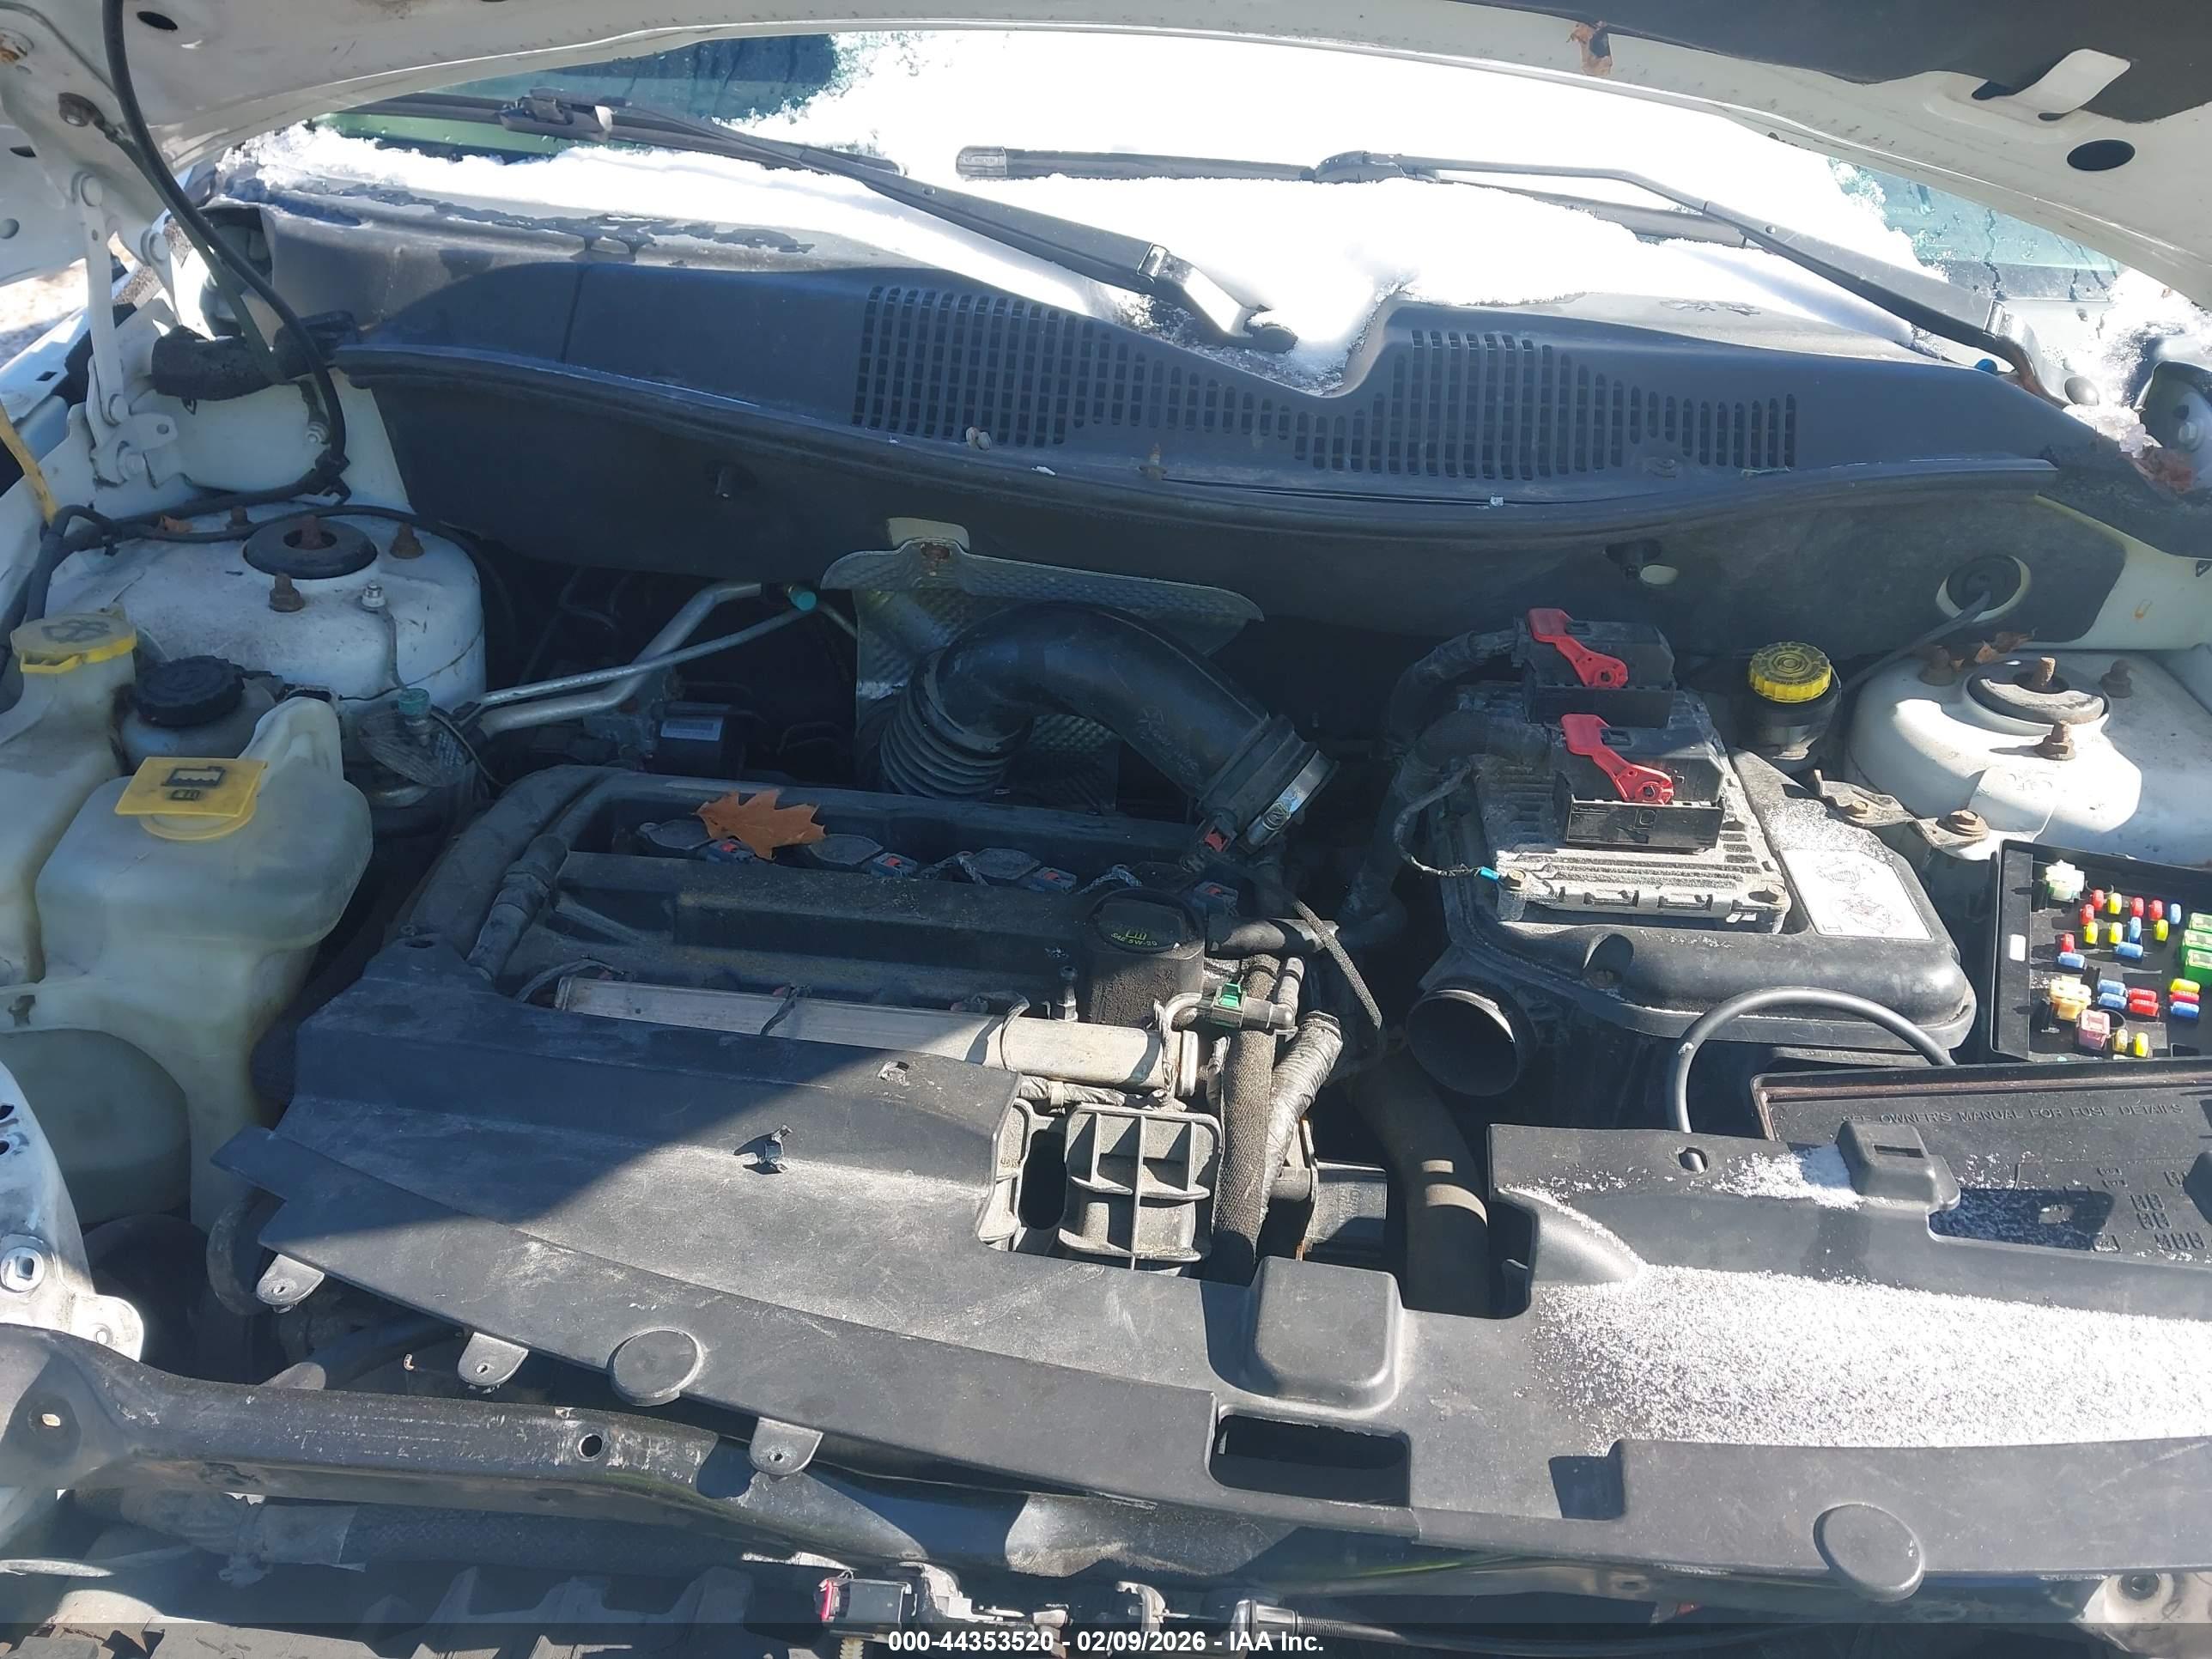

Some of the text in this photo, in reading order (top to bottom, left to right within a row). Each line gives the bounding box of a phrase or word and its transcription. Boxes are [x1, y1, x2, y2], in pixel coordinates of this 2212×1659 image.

[1111, 933, 1126, 942] SAE
[1958, 1110, 2023, 1121] MANUAL
[2028, 1107, 2064, 1118] FOR
[2069, 1105, 2112, 1117] FUSE
[2118, 1103, 2184, 1115] DETAILS
